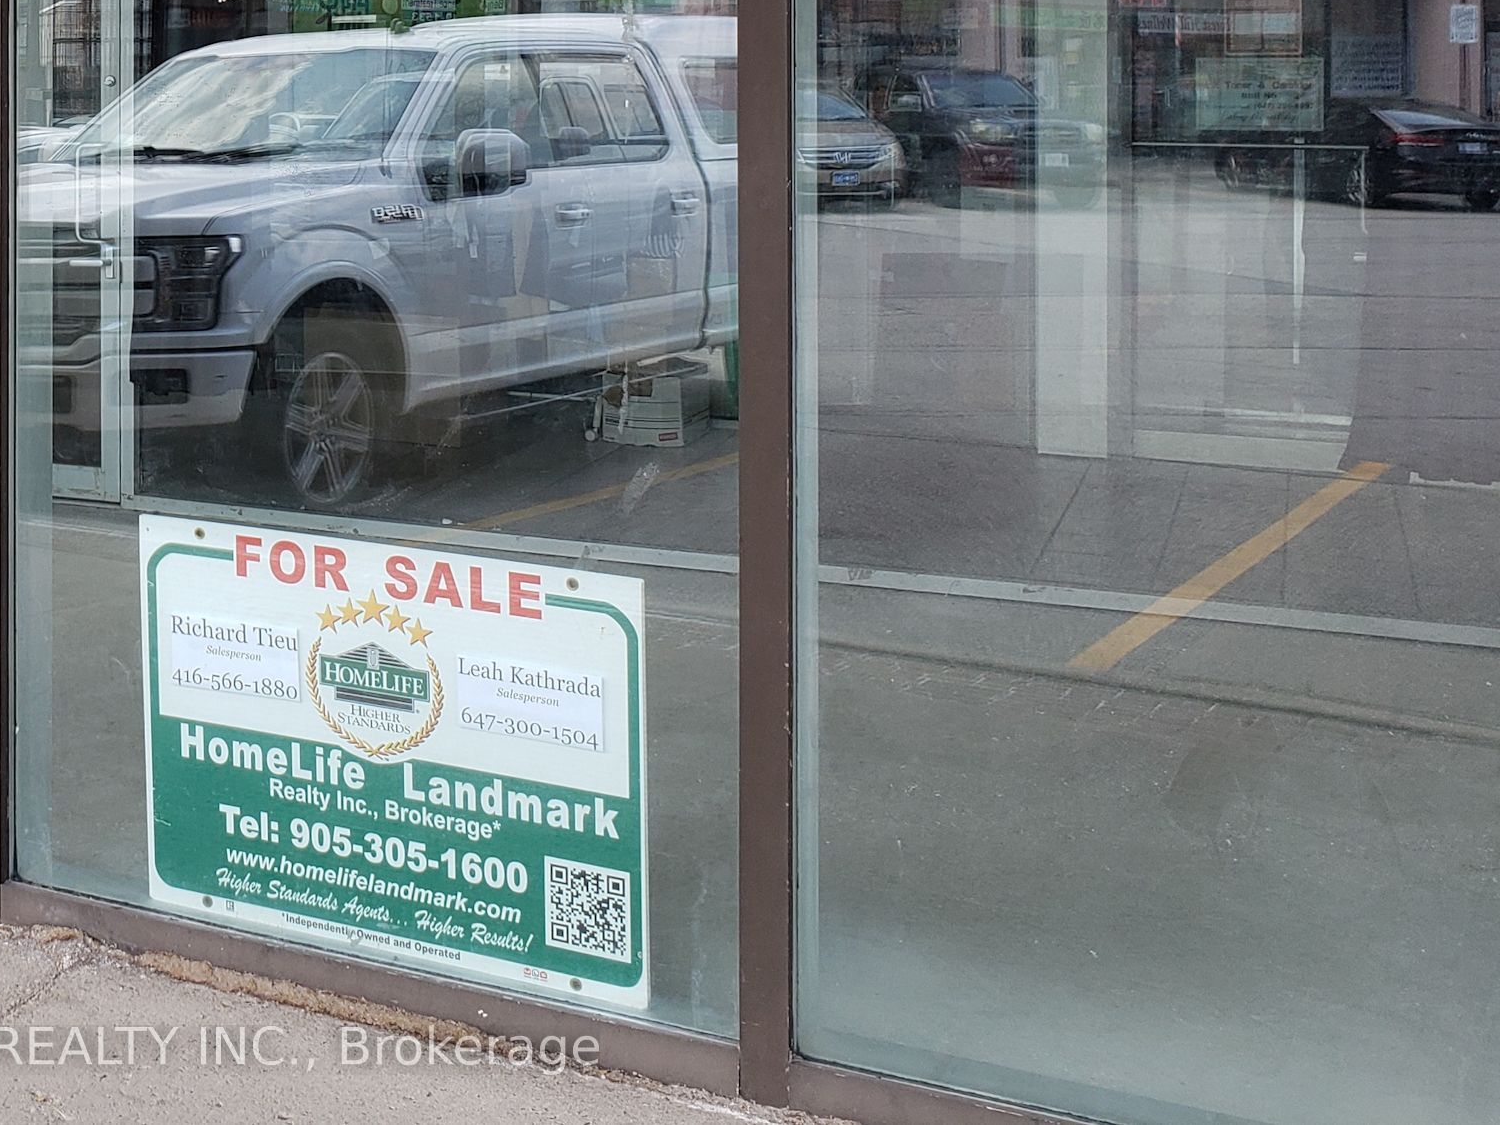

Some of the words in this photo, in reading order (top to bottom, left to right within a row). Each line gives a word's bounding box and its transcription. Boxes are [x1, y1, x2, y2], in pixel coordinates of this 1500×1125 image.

[235, 534, 350, 592] FOR
[384, 555, 543, 620] SALE
[171, 615, 247, 645] Richard
[253, 626, 298, 652] Tieu
[206, 645, 262, 662] Salesperson
[172, 668, 298, 701] 416-566-1880
[458, 657, 503, 681] Leah
[510, 665, 601, 698] Kathrada
[496, 687, 559, 707] Salesperson
[337, 711, 411, 735] STANDARDS
[350, 704, 401, 723] HIGHER
[461, 707, 599, 751] 647-300-1504
[180, 722, 366, 789] HomeLife
[403, 761, 620, 840] Landmark
[269, 777, 331, 811] Realty
[337, 790, 379, 820] Inc.,
[219, 803, 279, 843] Tel:
[290, 817, 528, 894] 905-305-1600
[226, 848, 522, 924] www.homelifelandmark.com
[216, 867, 262, 896] Higher
[267, 879, 339, 911] Standards
[415, 909, 465, 939] Higher
[471, 922, 534, 954] Results!
[356, 930, 390, 945] Owned
[393, 939, 411, 950] and
[414, 942, 461, 961] Operated
